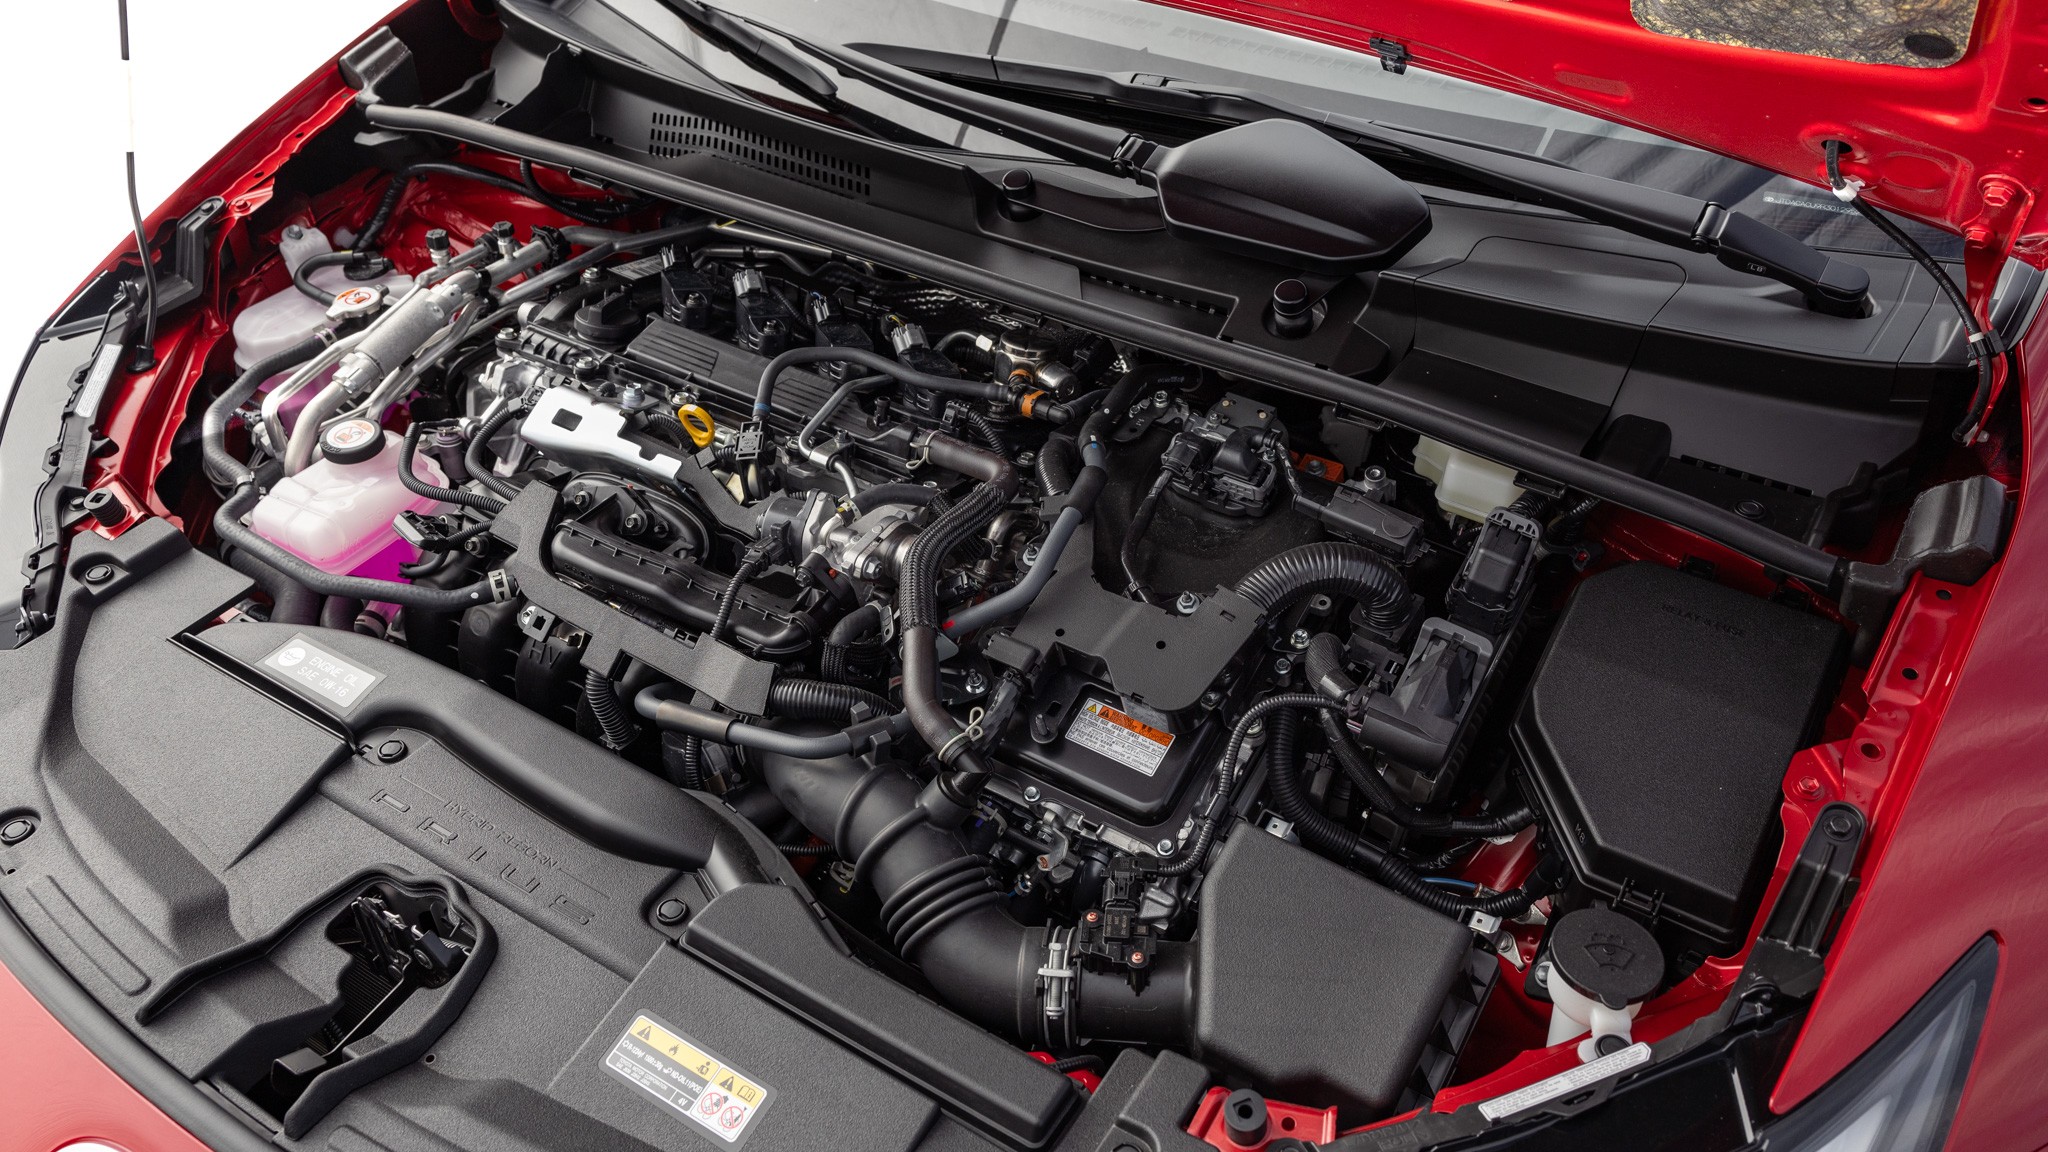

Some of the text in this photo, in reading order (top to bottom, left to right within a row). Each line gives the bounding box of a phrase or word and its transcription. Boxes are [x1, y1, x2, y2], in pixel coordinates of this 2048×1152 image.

[529, 639, 562, 669] HV
[297, 666, 320, 681] SAE
[308, 656, 360, 688] ENGINE OIL
[444, 801, 560, 870] HYBRID REBORN
[370, 788, 596, 926] PRIUS
